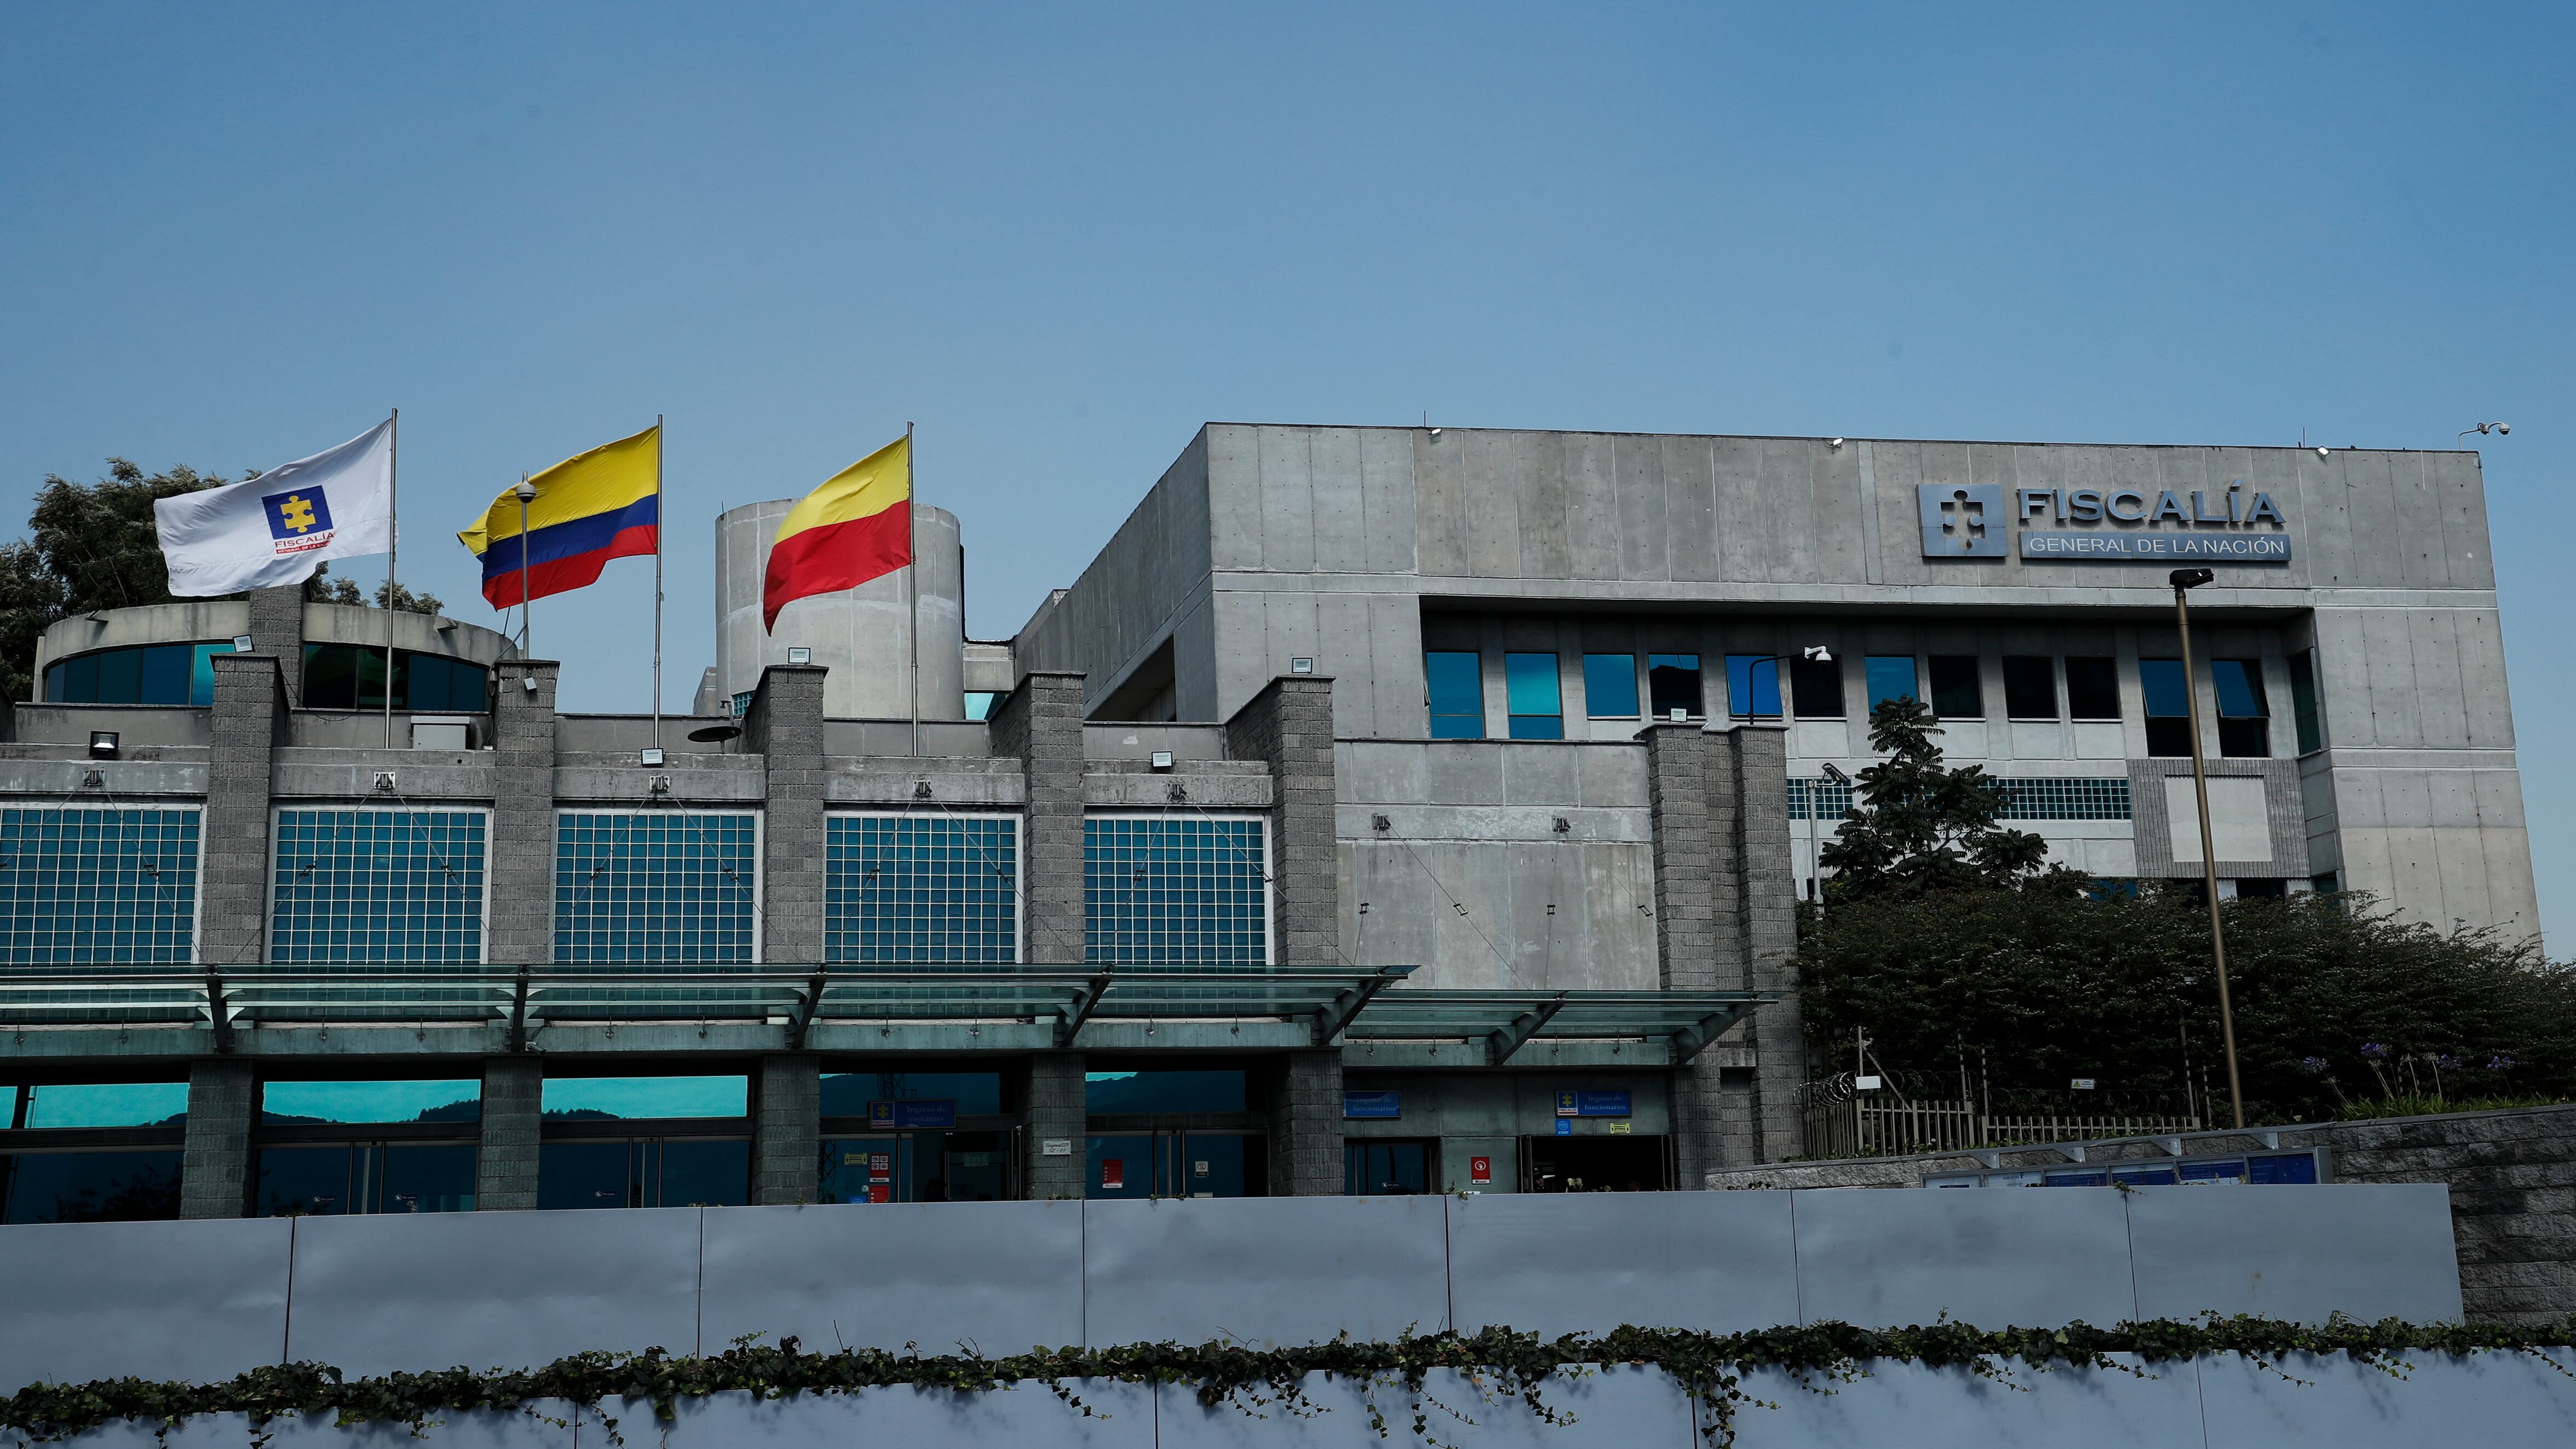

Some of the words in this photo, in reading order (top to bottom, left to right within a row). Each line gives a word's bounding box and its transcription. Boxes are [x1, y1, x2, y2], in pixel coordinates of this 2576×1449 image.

[2017, 478, 2287, 523] FISCALÍA
[275, 532, 334, 547] FISCALÍA
[2030, 538, 2132, 553] GENERAL
[2137, 539, 2166, 553] DE
[2172, 539, 2199, 553] LA
[2203, 537, 2285, 554] NACIÓN
[907, 1105, 934, 1114] Ingreso
